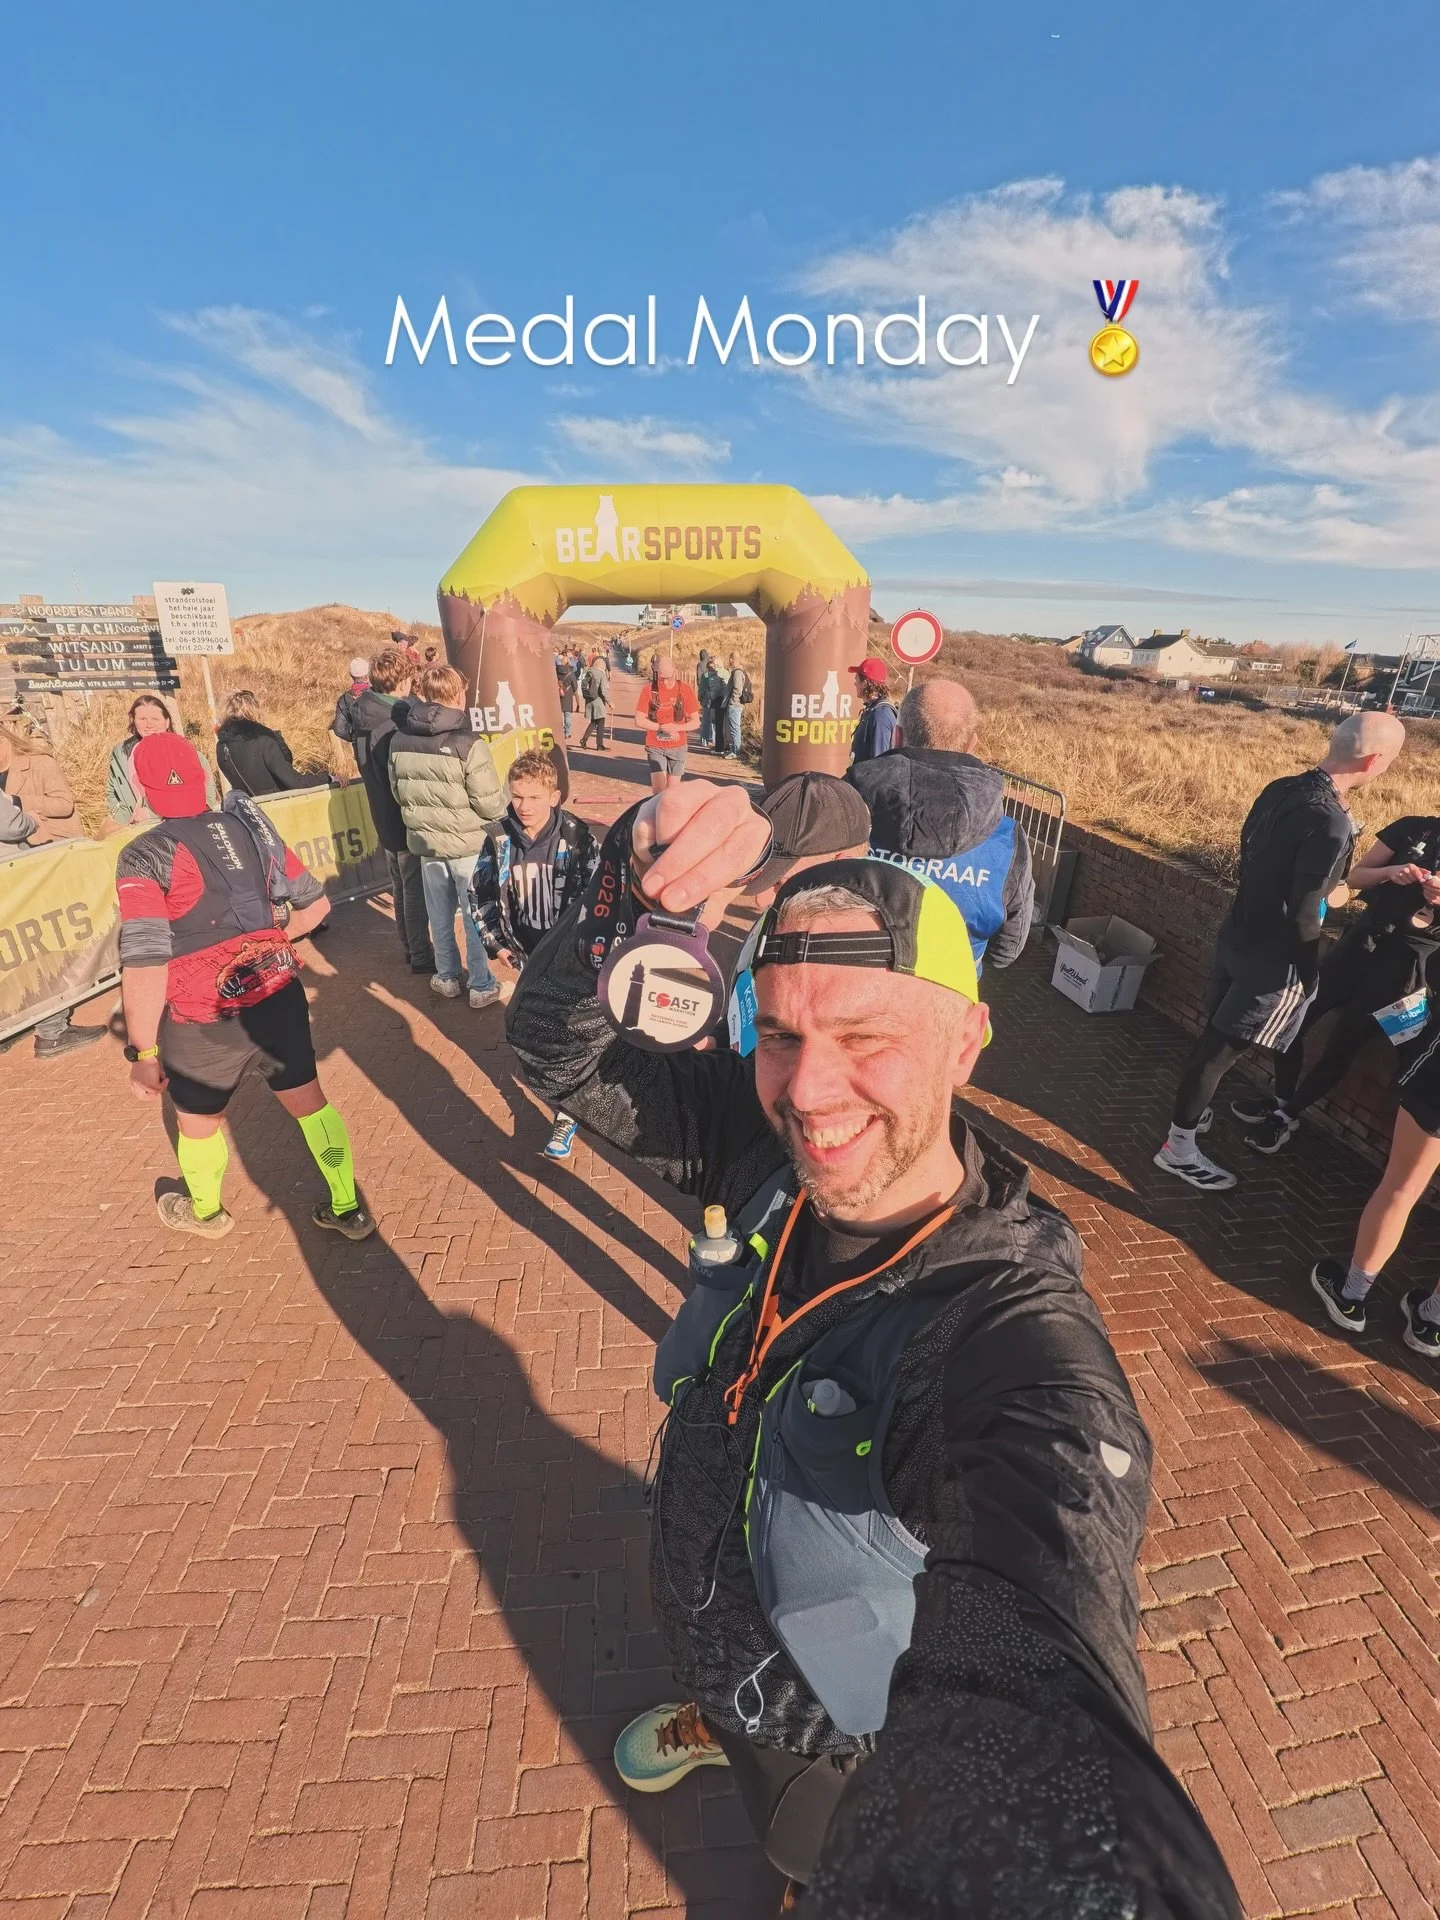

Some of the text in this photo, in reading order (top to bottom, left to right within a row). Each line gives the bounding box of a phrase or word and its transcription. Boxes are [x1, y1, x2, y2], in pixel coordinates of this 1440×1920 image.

[27, 605, 133, 617] NOORDERSTRAND
[48, 641, 126, 654] WITSAND
[55, 659, 126, 672] TULUM
[469, 681, 536, 732] BEAR
[791, 671, 852, 719] BEAR
[214, 822, 244, 870] SALOMON
[593, 860, 616, 918] 2026
[648, 991, 700, 1012] COAST
